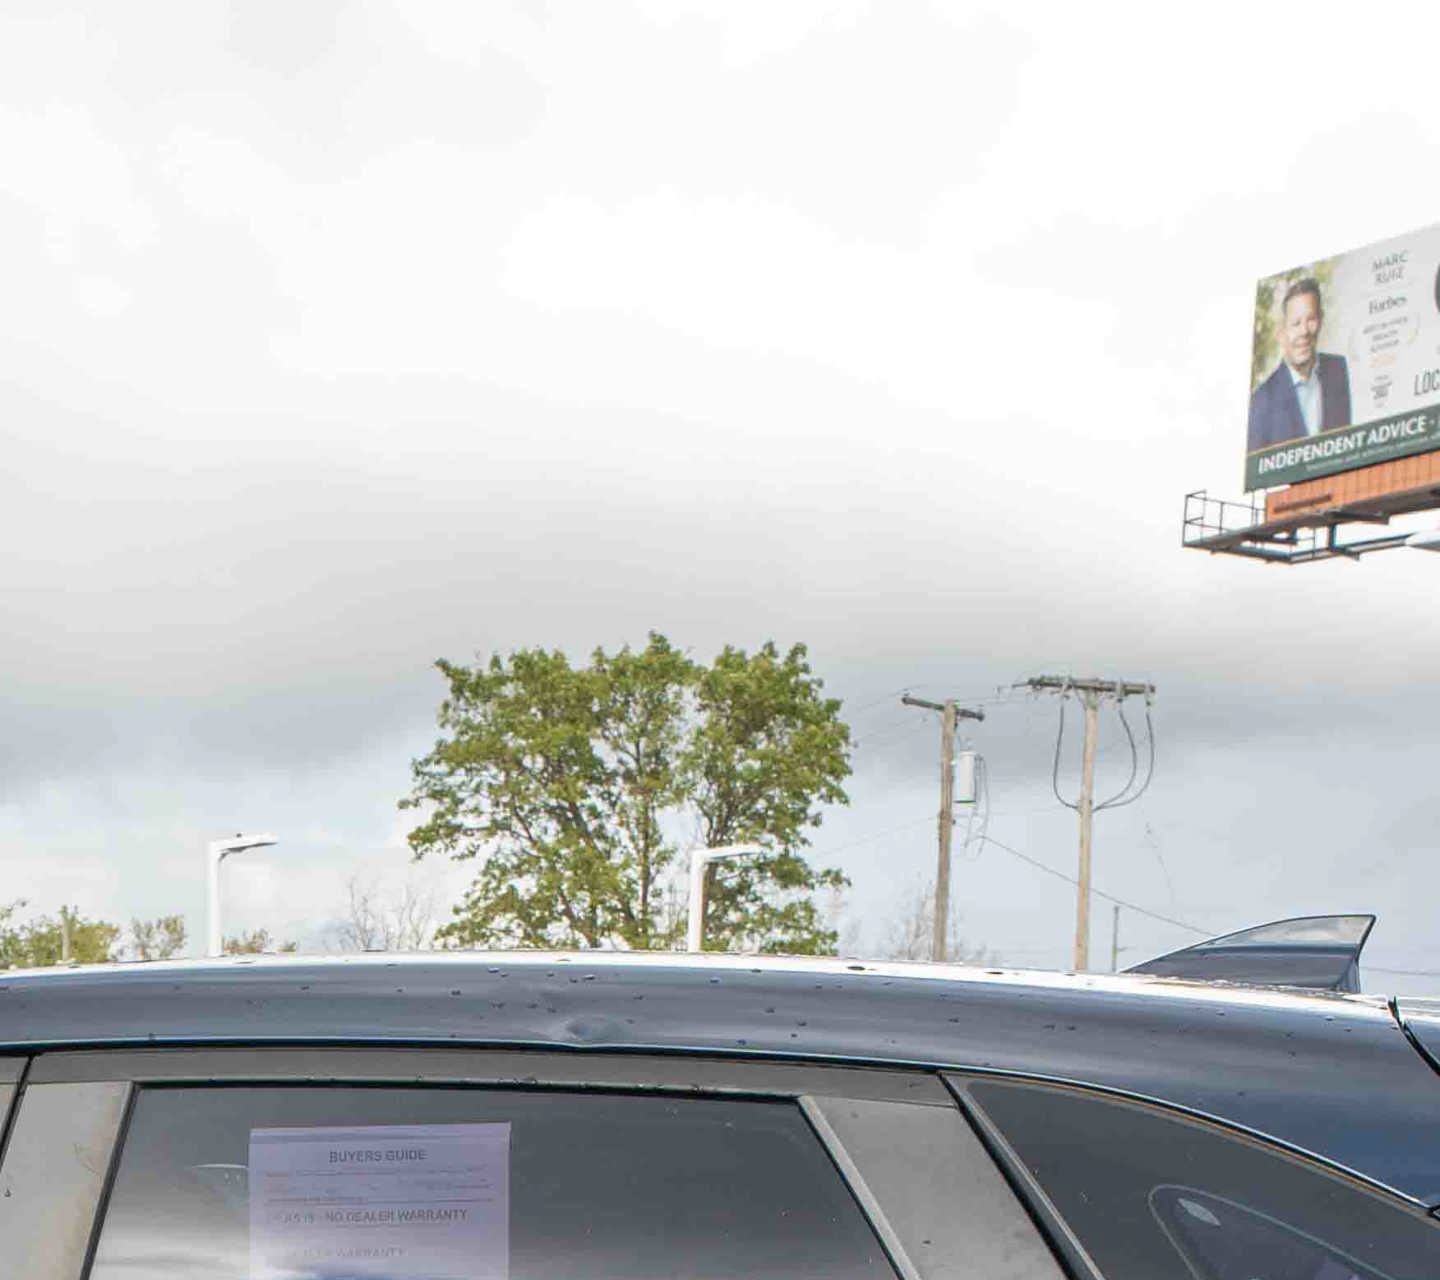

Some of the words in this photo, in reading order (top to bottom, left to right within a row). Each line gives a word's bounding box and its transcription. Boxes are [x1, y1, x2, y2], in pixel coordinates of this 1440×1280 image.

[1371, 250, 1409, 273] MARC
[1258, 432, 1366, 475] INDEPENDENT
[1366, 415, 1426, 446] ADVICE
[329, 1150, 382, 1163] BUYERS
[386, 1149, 427, 1161] GUIDE
[398, 1208, 468, 1221] WARRANTY
